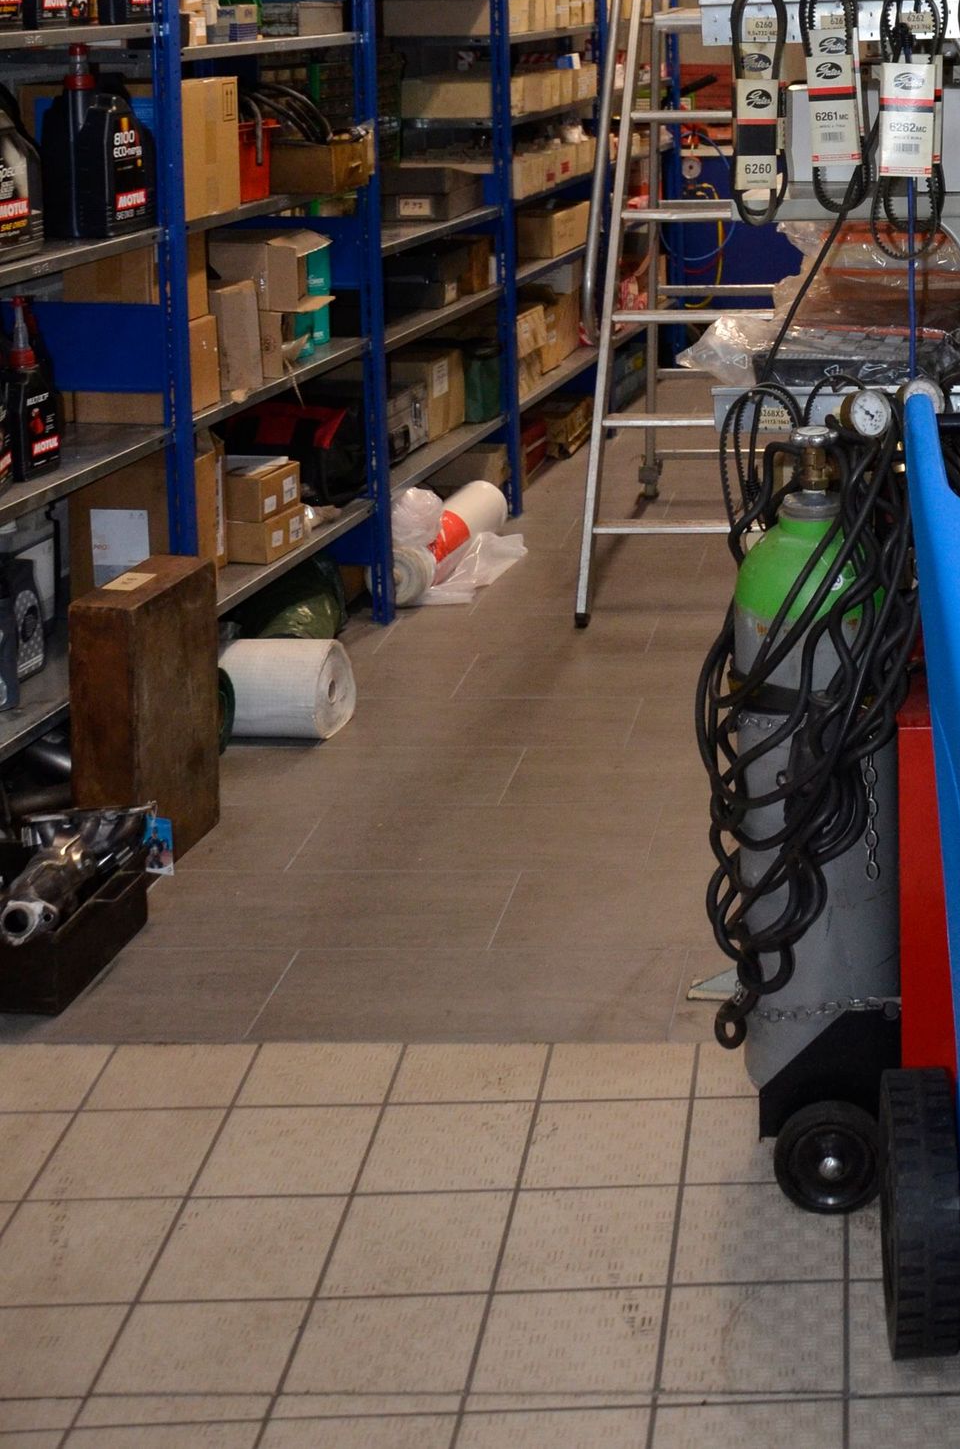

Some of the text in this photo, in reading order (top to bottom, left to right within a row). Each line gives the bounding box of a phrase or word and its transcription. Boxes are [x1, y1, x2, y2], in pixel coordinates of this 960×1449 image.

[907, 14, 924, 22] 6262
[816, 62, 843, 79] Gates
[746, 89, 772, 109] Gates
[889, 122, 928, 133] 6262MC
[114, 130, 135, 146] 8100
[745, 164, 771, 174] 6260
[117, 191, 146, 208] MOTUL
[34, 436, 59, 451] MOTUL
